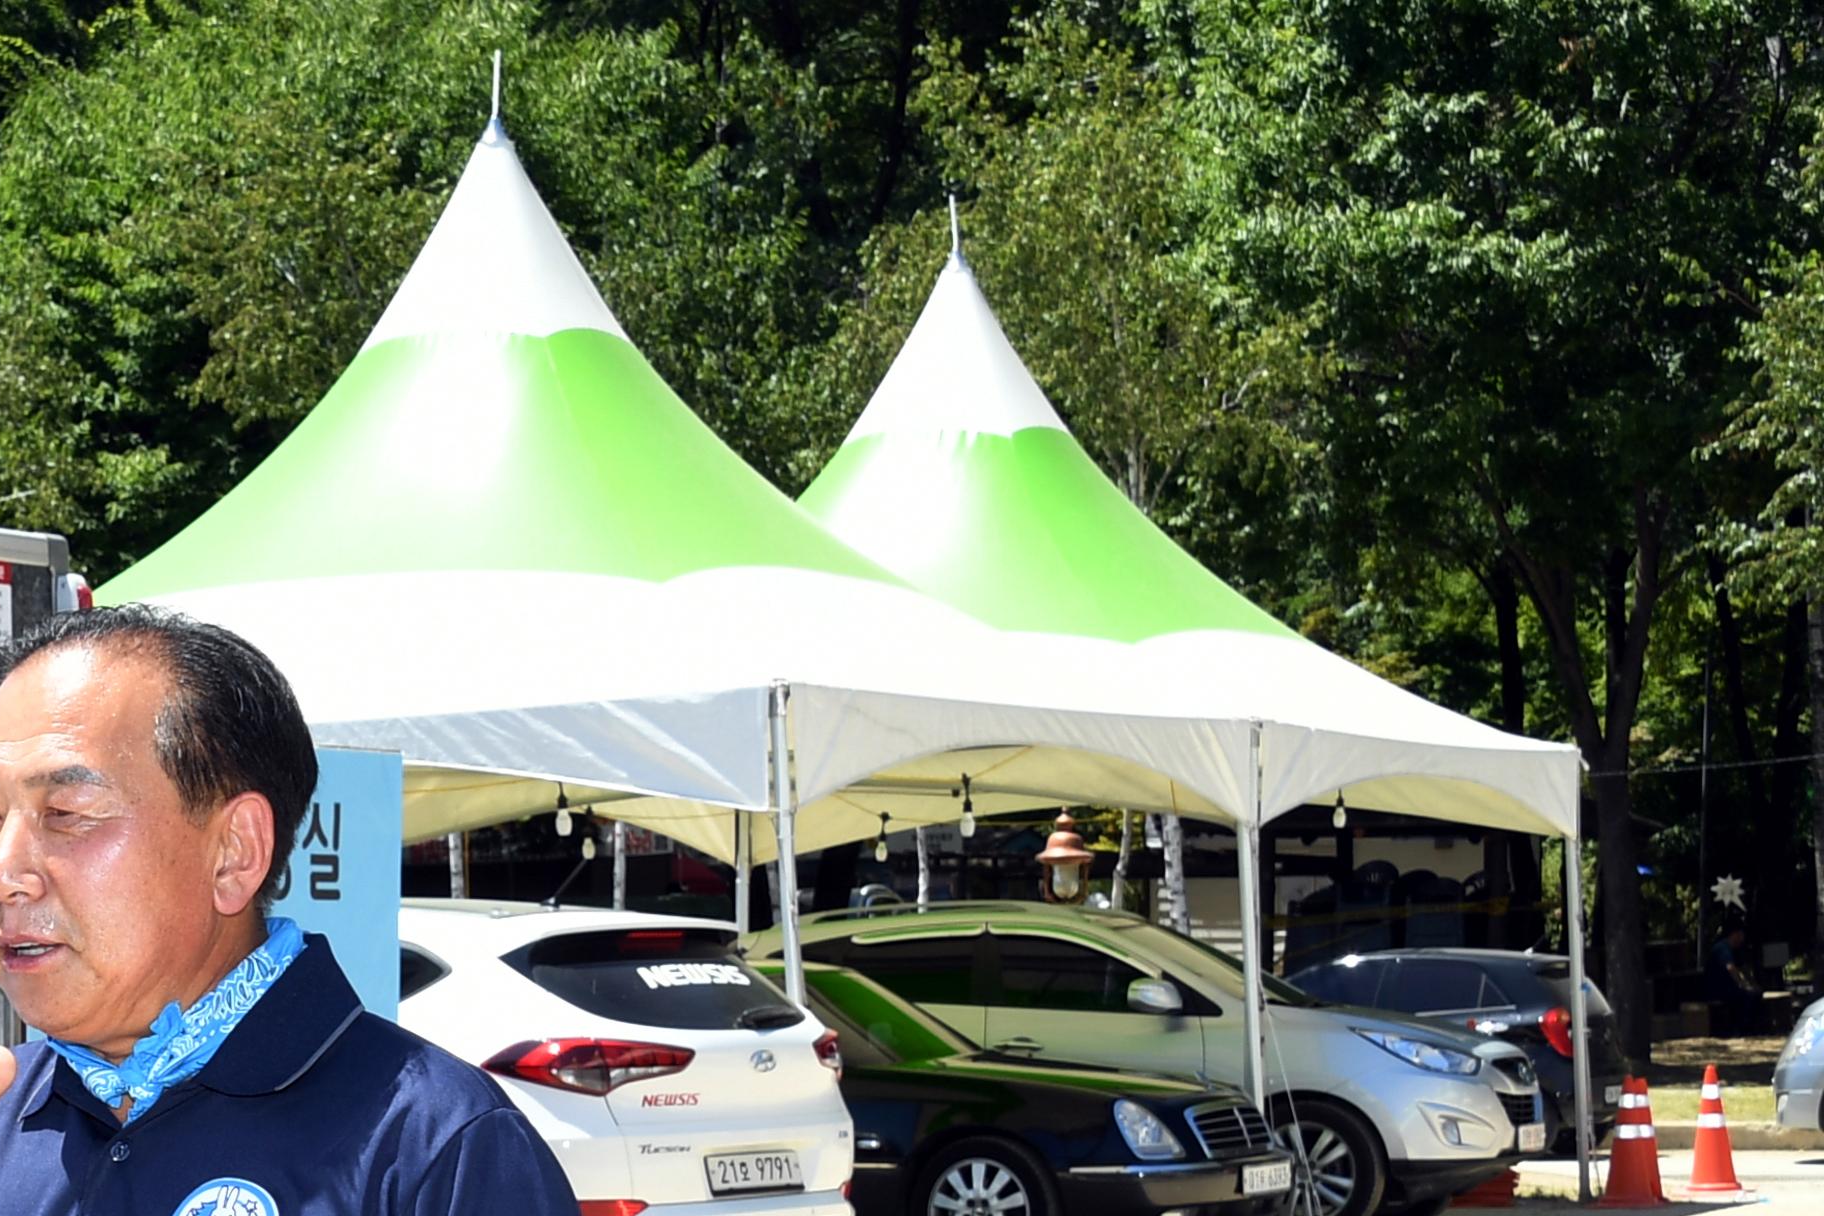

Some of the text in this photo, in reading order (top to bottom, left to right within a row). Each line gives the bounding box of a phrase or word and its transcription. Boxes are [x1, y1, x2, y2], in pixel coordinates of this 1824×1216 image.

[636, 963, 752, 989] NEWSIS
[641, 1093, 701, 1108] NEWSIS
[755, 1156, 793, 1182] 9791
